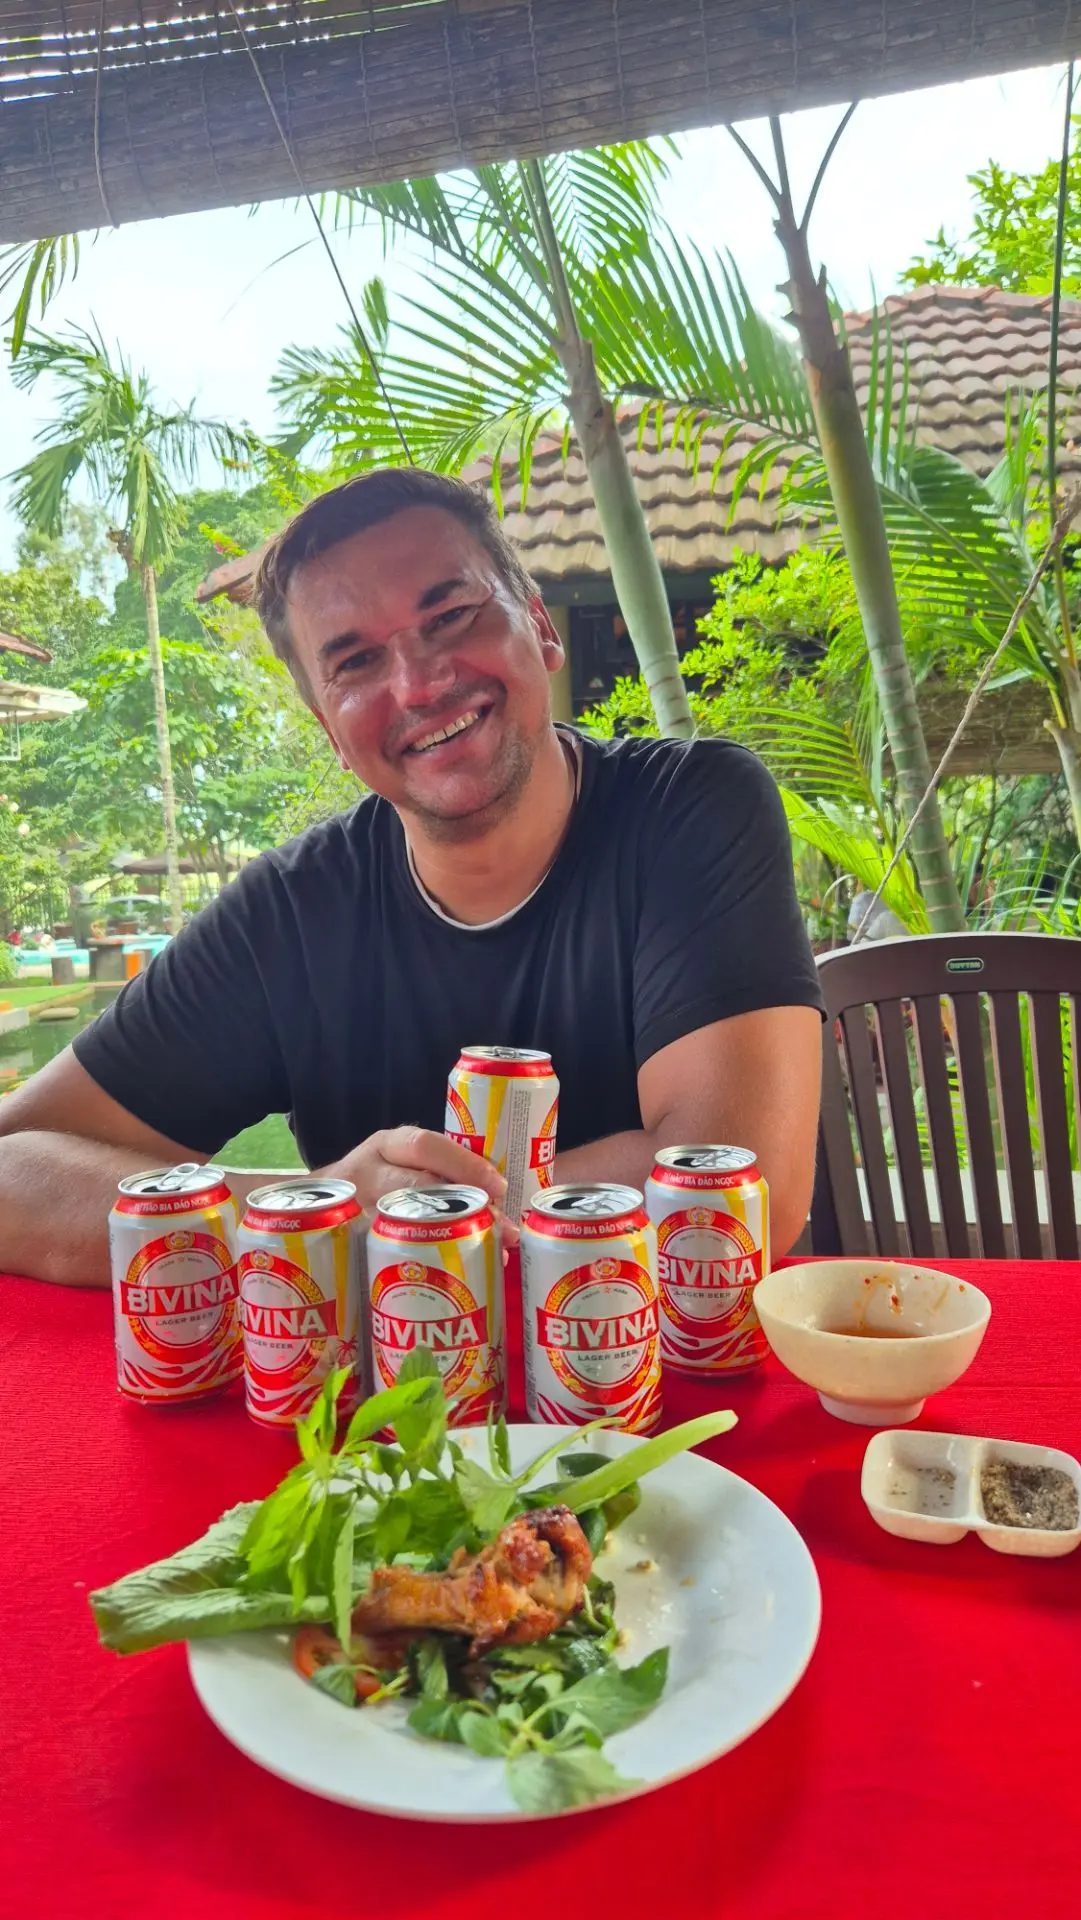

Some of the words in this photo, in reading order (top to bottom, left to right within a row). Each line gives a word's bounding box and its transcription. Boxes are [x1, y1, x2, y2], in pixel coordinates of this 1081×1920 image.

[583, 1225, 597, 1234] BIA
[658, 1255, 757, 1287] BIVINA
[127, 1273, 235, 1313] BIVINA
[707, 1291, 731, 1299] BEER
[156, 1315, 187, 1326] LAGER
[372, 1310, 479, 1348] BIVINA
[545, 1307, 657, 1348] BIVINA
[578, 1354, 610, 1362] LAGER
[614, 1348, 638, 1360] BEER
